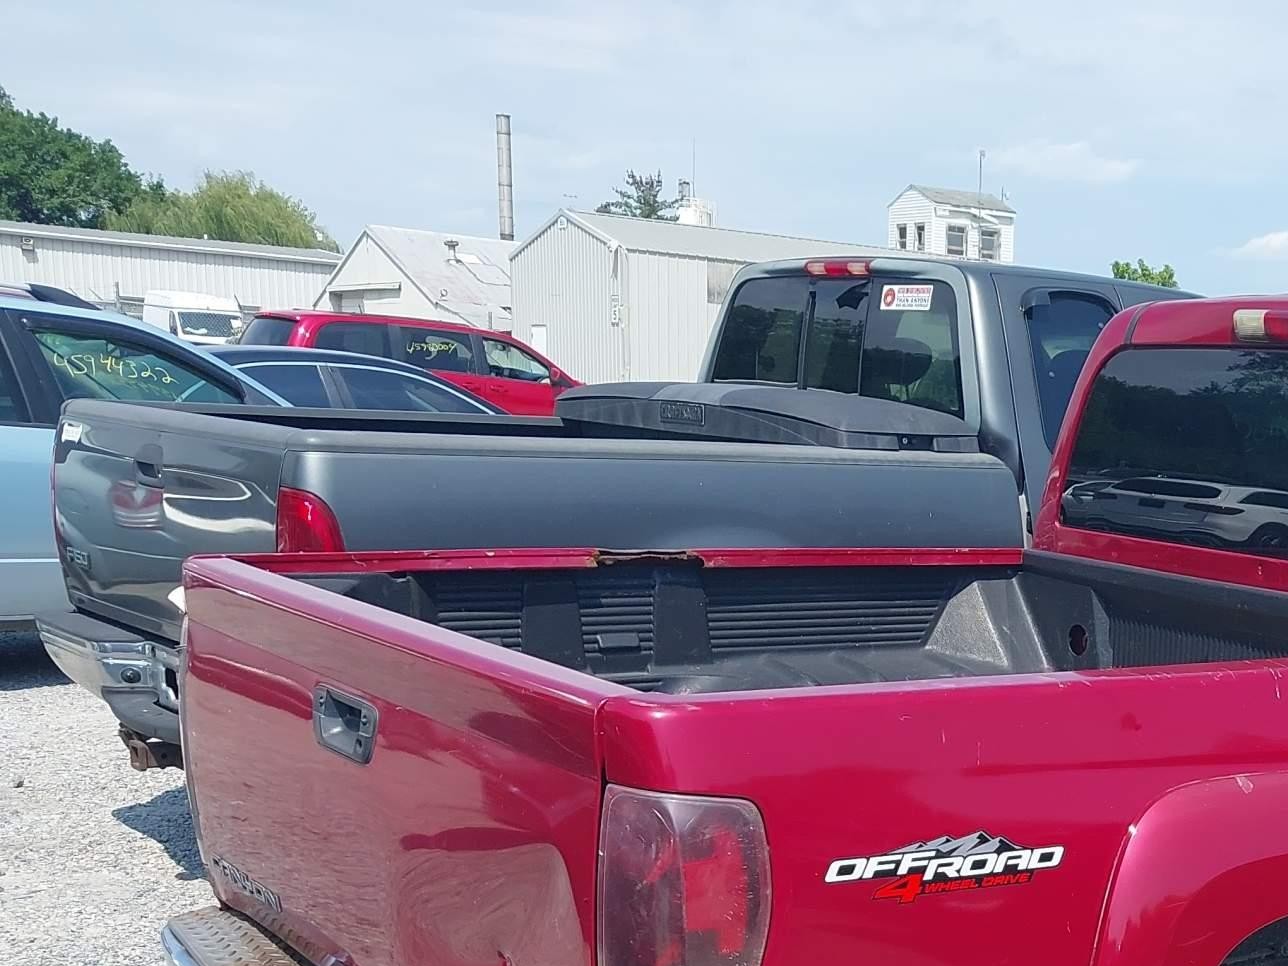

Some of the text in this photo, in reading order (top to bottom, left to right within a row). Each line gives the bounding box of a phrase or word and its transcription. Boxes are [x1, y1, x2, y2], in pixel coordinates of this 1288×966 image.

[53, 352, 180, 385] 45944322
[825, 847, 1064, 882] OFFROAD
[872, 873, 1031, 903] 4 WHEEL DRIVE
